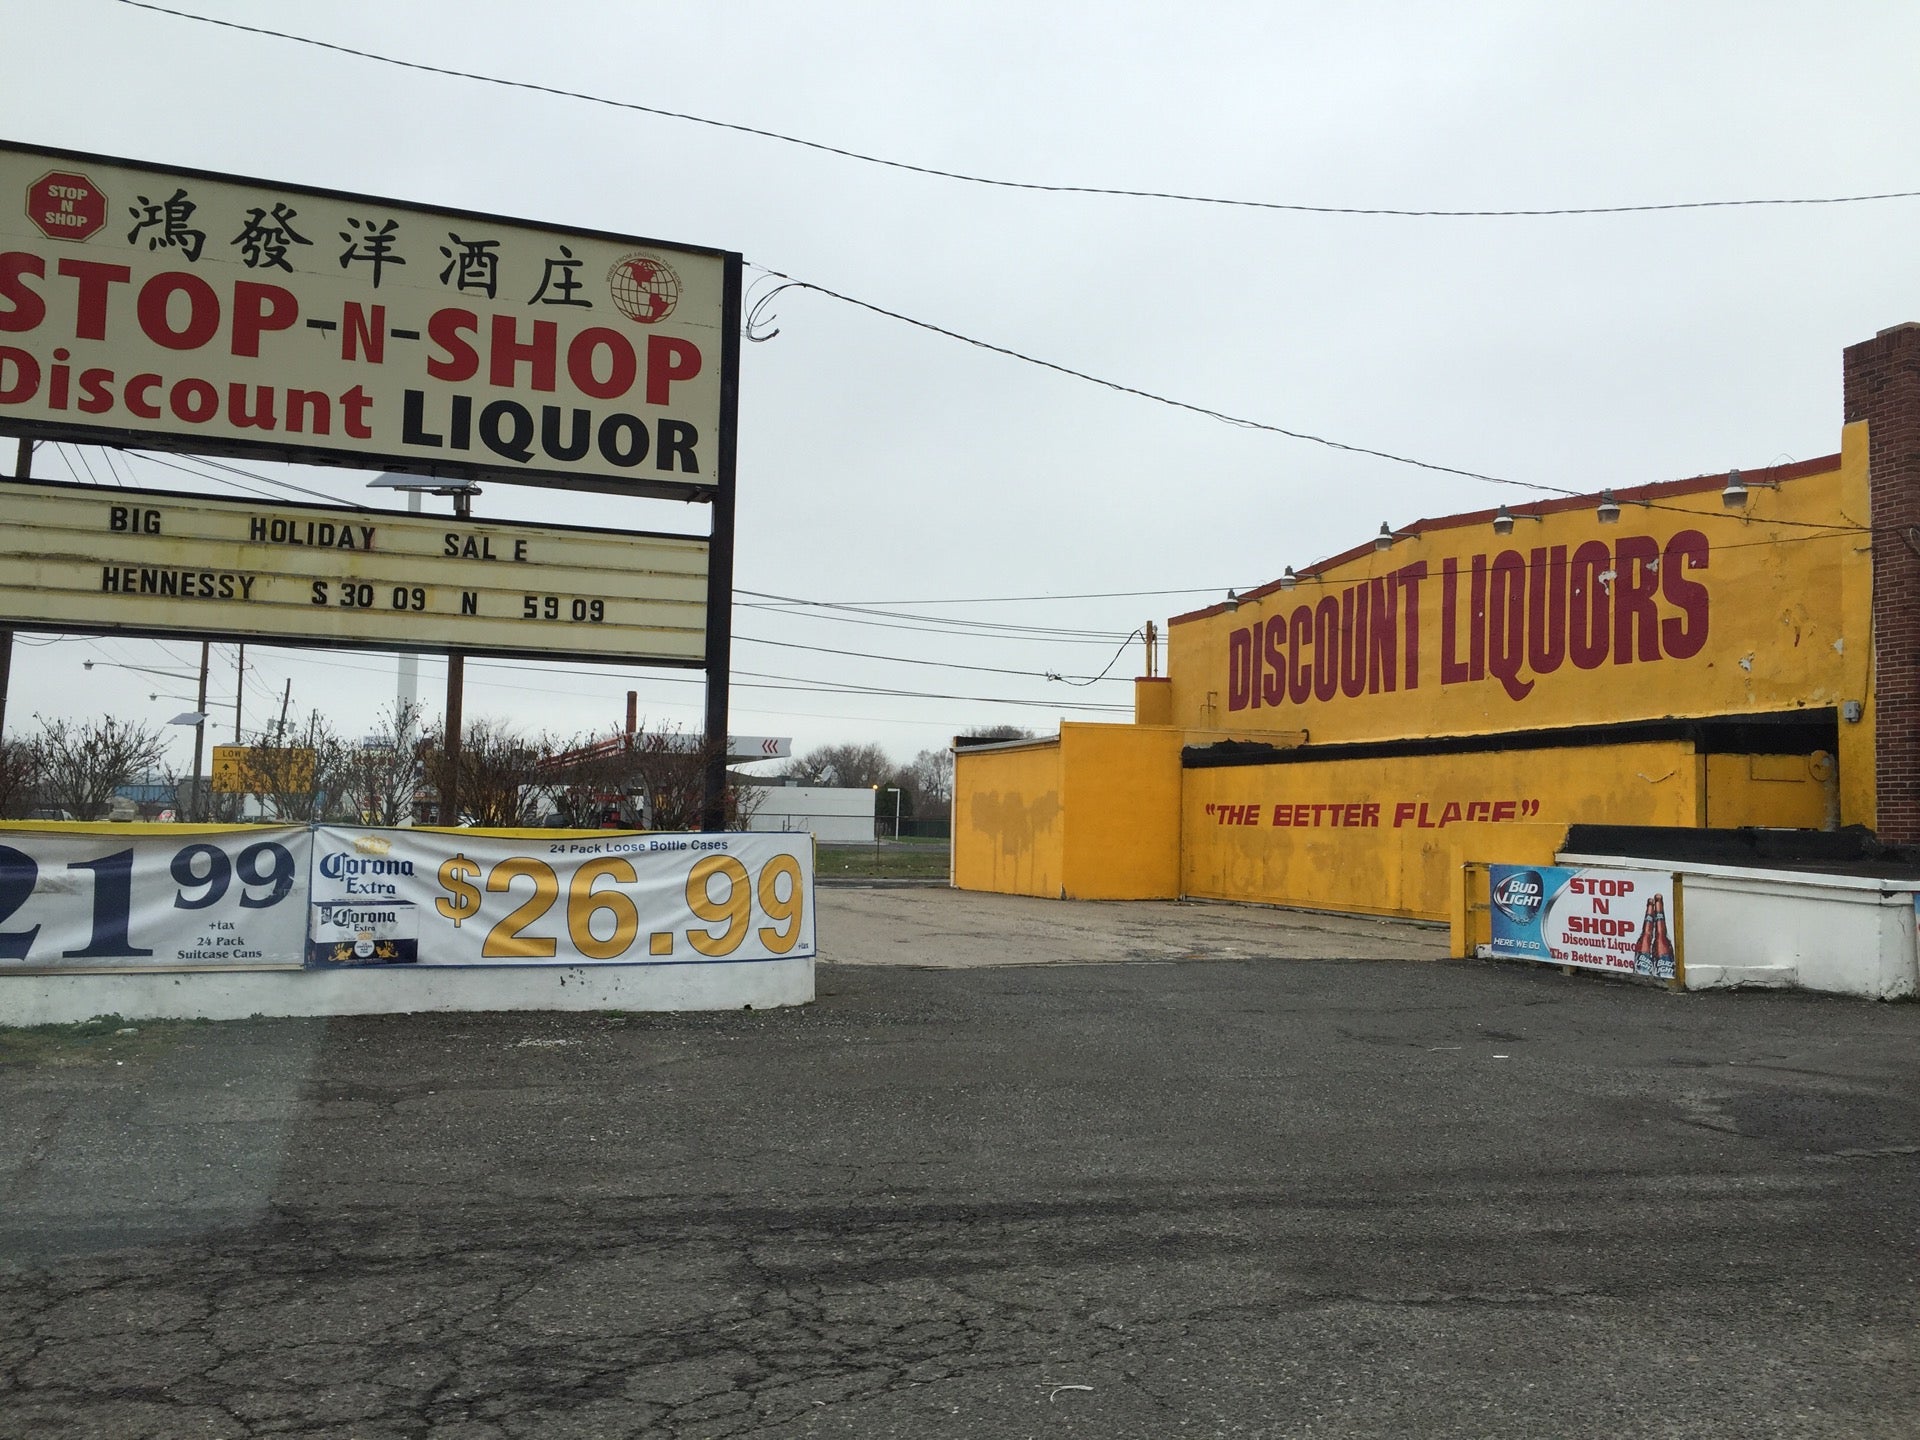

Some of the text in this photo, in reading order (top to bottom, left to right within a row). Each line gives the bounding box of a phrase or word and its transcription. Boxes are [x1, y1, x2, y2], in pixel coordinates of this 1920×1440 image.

[48, 185, 88, 198] STOP
[61, 201, 74, 213] N
[45, 212, 88, 227] SHOP
[0, 346, 701, 474] Discount LIQUOR
[110, 506, 161, 534] BIG
[251, 517, 376, 550] HOLIDAY
[102, 566, 256, 599] HENNESSY
[462, 592, 478, 615] N
[1229, 529, 1710, 711] DISCOUNT LIQUORS
[1272, 802, 1380, 828] BETTER
[550, 839, 729, 854] 24 Pack Loose Bottle Cases
[320, 852, 415, 881] Corona
[346, 876, 396, 895] Extra
[1508, 880, 1539, 894] BUD
[1569, 878, 1634, 897] STOP
[435, 853, 804, 960] $26.99
[1501, 892, 1542, 907] LIGHT
[1592, 898, 1610, 915] N
[209, 920, 235, 930] +tax
[332, 908, 397, 928] Corona
[1568, 916, 1635, 937] SHOP
[354, 924, 376, 932] Extra
[197, 936, 245, 946] 24 Pack
[1493, 937, 1540, 950] HERE WE GO
[1562, 932, 1606, 949] Discount
[177, 949, 263, 960] Suitcase Cans
[1550, 948, 1635, 969] The Better Place
